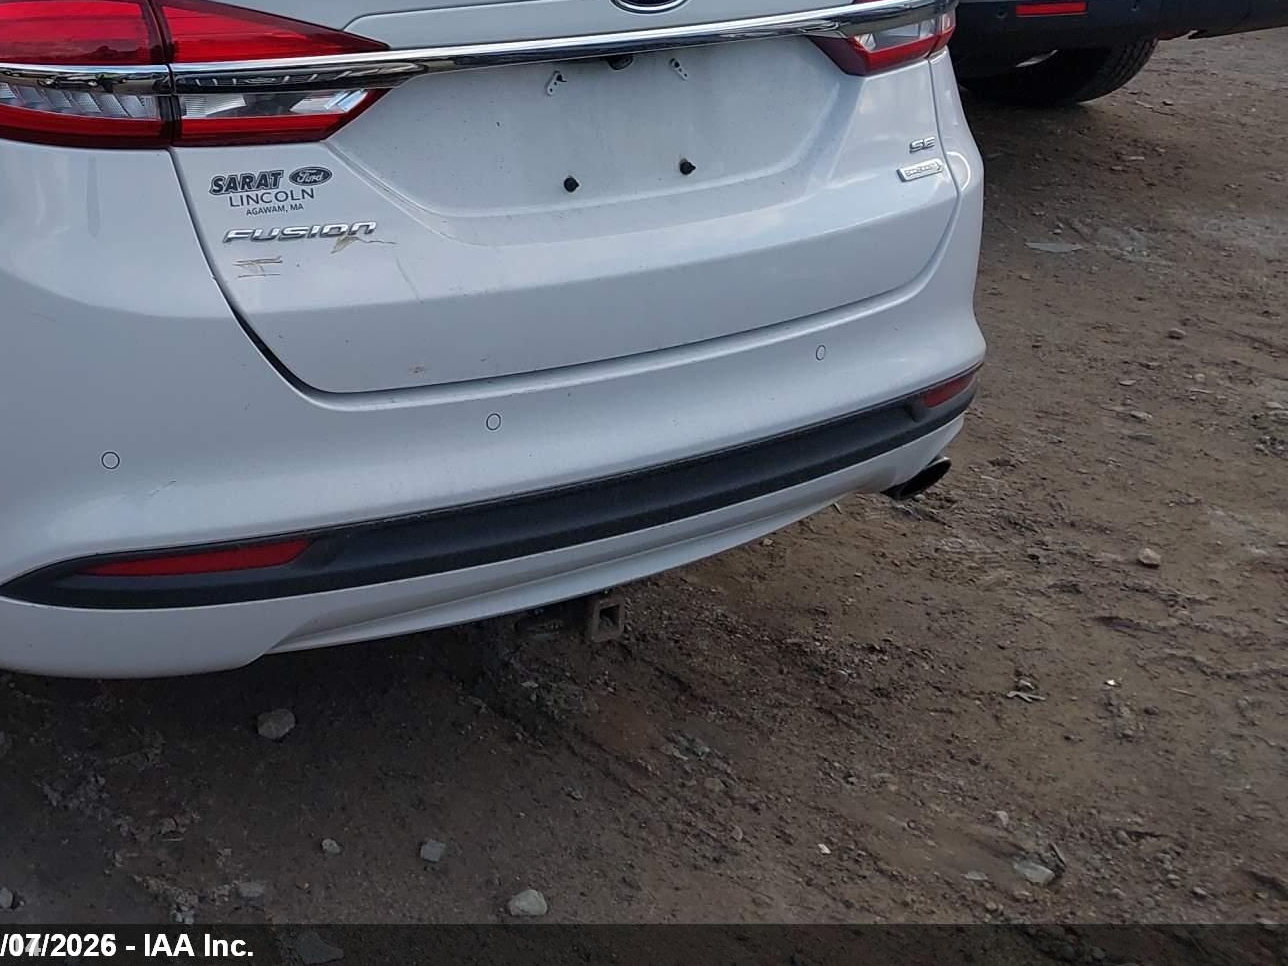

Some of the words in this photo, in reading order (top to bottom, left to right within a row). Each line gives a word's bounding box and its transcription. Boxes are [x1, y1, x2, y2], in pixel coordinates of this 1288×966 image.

[908, 135, 936, 154] SE
[209, 169, 285, 196] SARAT
[294, 168, 327, 184] Ford
[229, 188, 315, 208] LINCOLN
[245, 205, 288, 216] AGAWAM,
[290, 203, 304, 211] MA
[223, 220, 377, 244] FUSION
